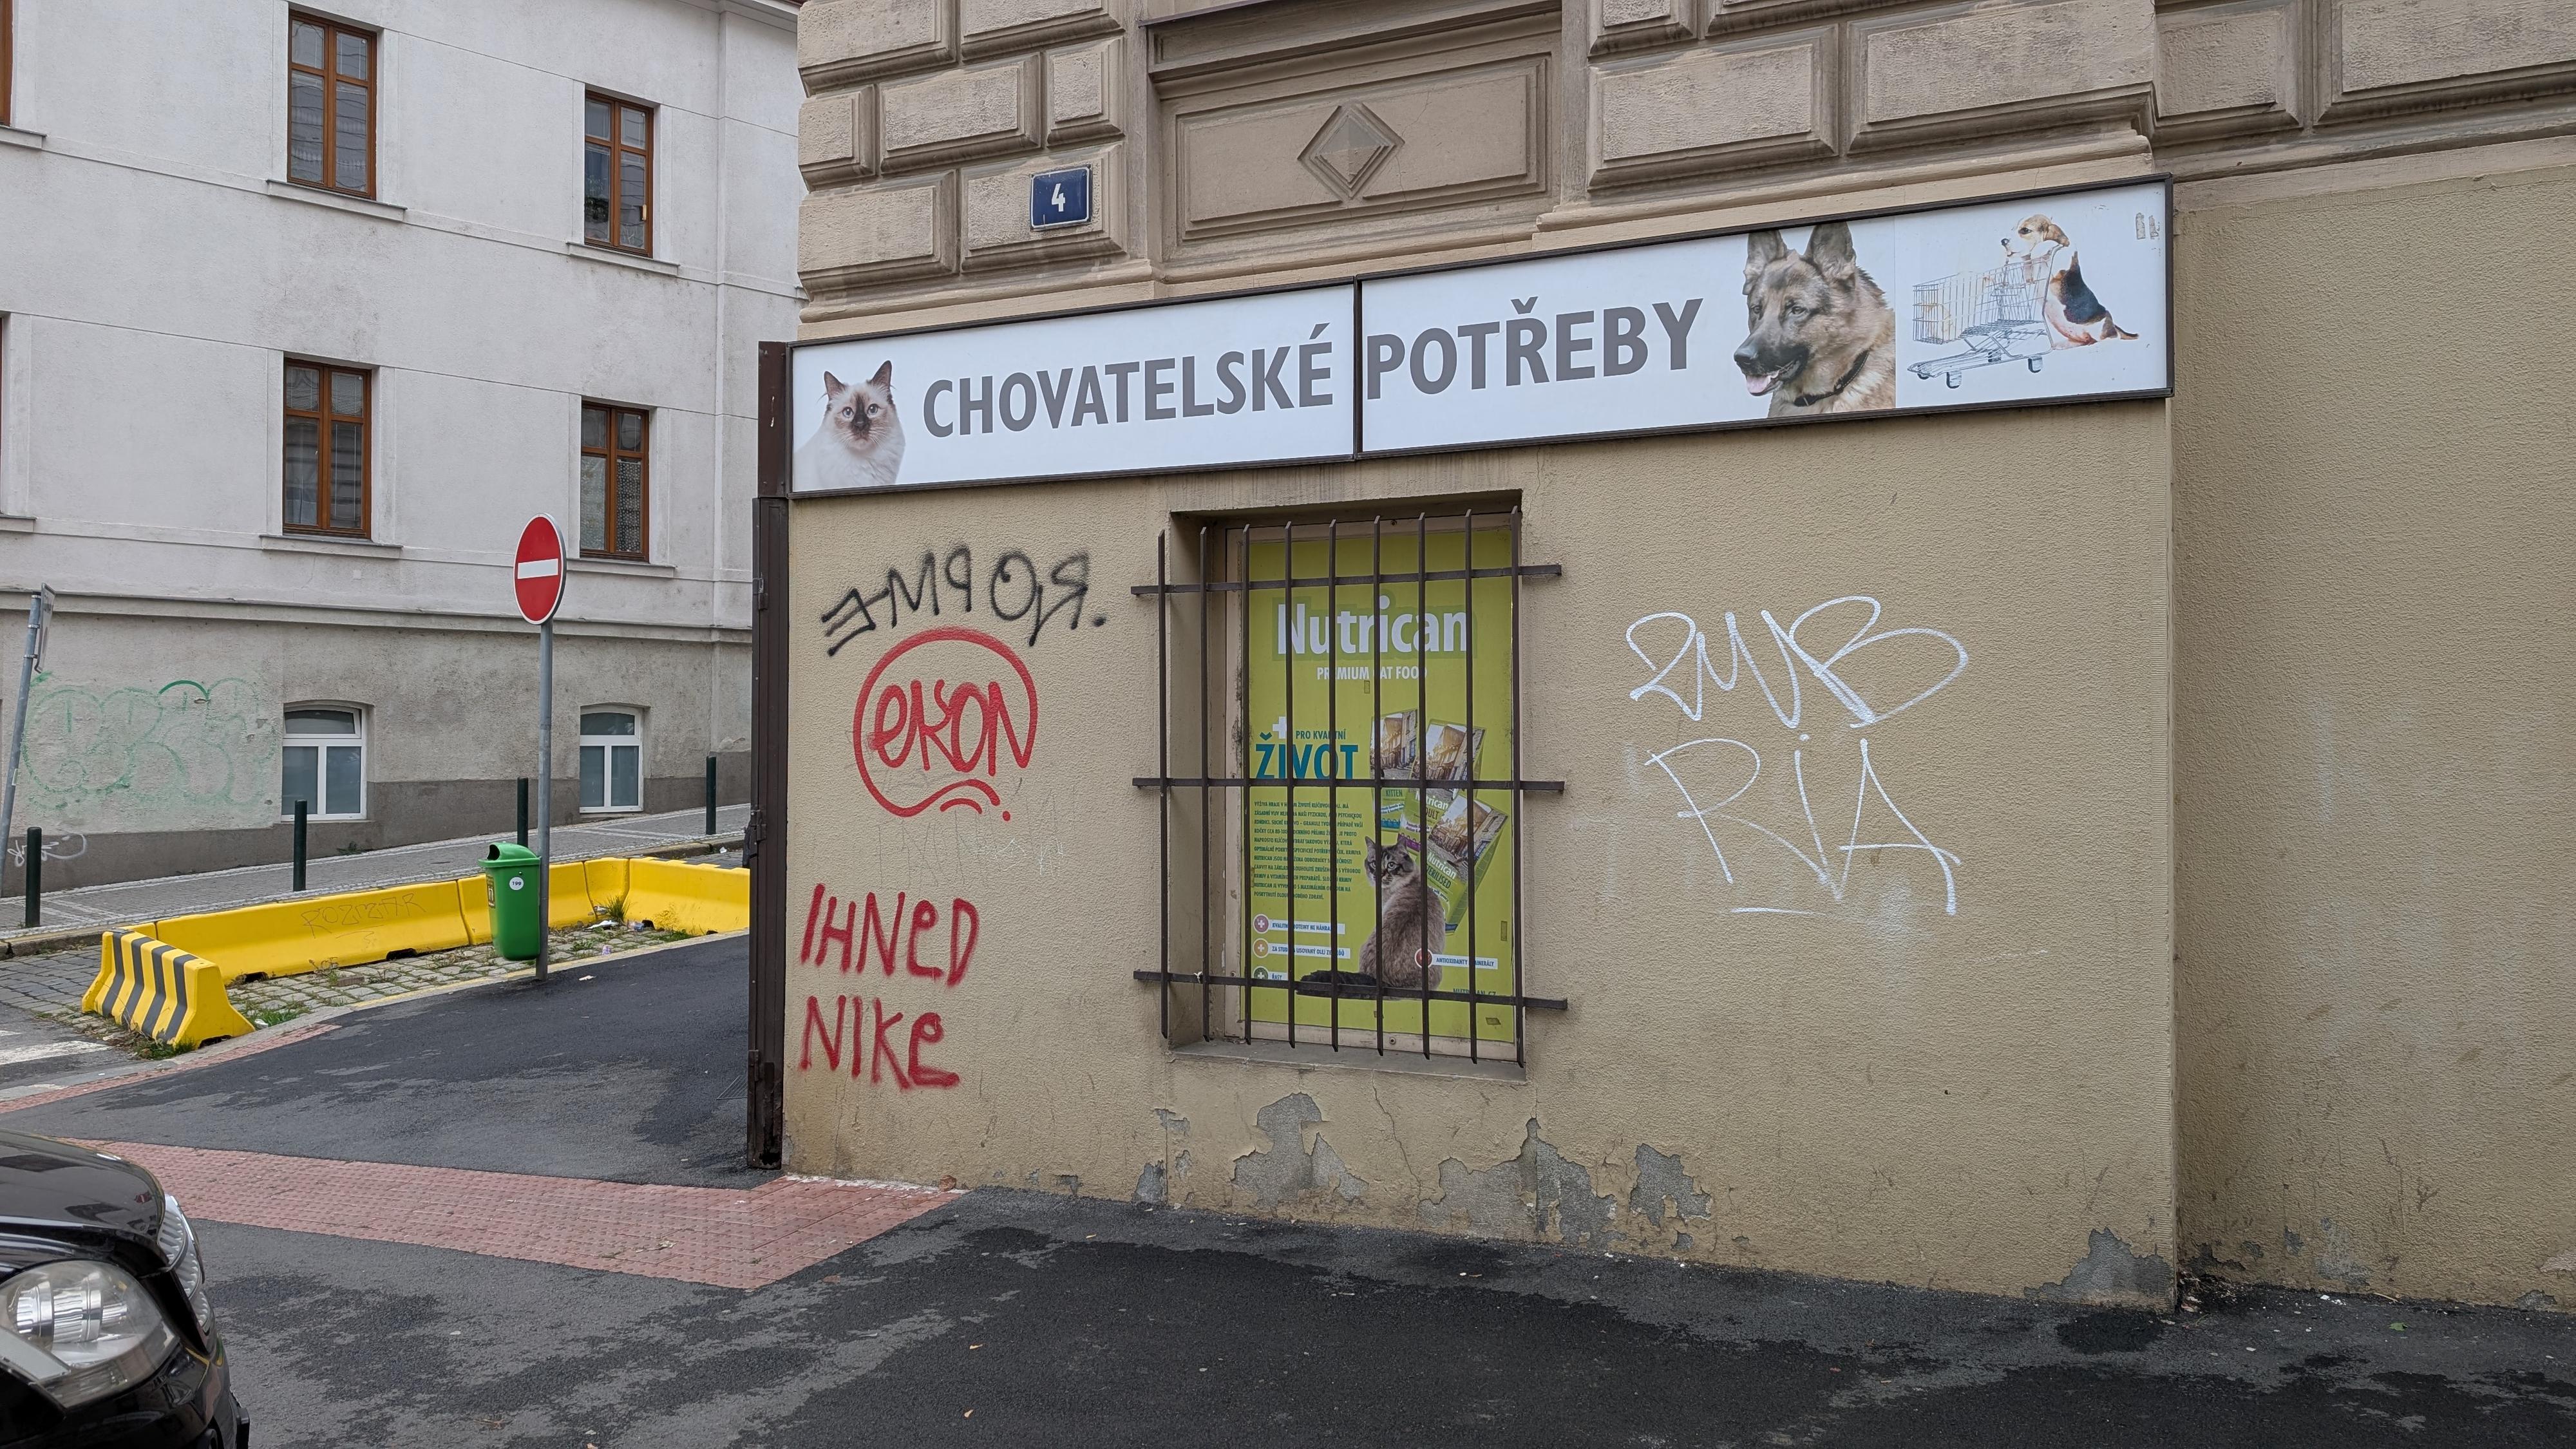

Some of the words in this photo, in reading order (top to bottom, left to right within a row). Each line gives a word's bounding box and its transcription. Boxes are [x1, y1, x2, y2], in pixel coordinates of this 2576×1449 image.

[1052, 183, 1066, 212] 4
[923, 323, 1333, 438] CHOVATELSKÉ
[1367, 296, 1703, 400] POTŘEBY
[1317, 666, 1370, 680] PRMIUM
[1373, 666, 1393, 679] AT
[1396, 665, 1427, 679] FOO
[1296, 730, 1311, 740] PRO
[1256, 732, 1358, 779] ŽIVOT
[1386, 789, 1403, 797] KITTEN
[1426, 864, 1452, 889] TERILISED
[1427, 851, 1457, 880] Nutrican
